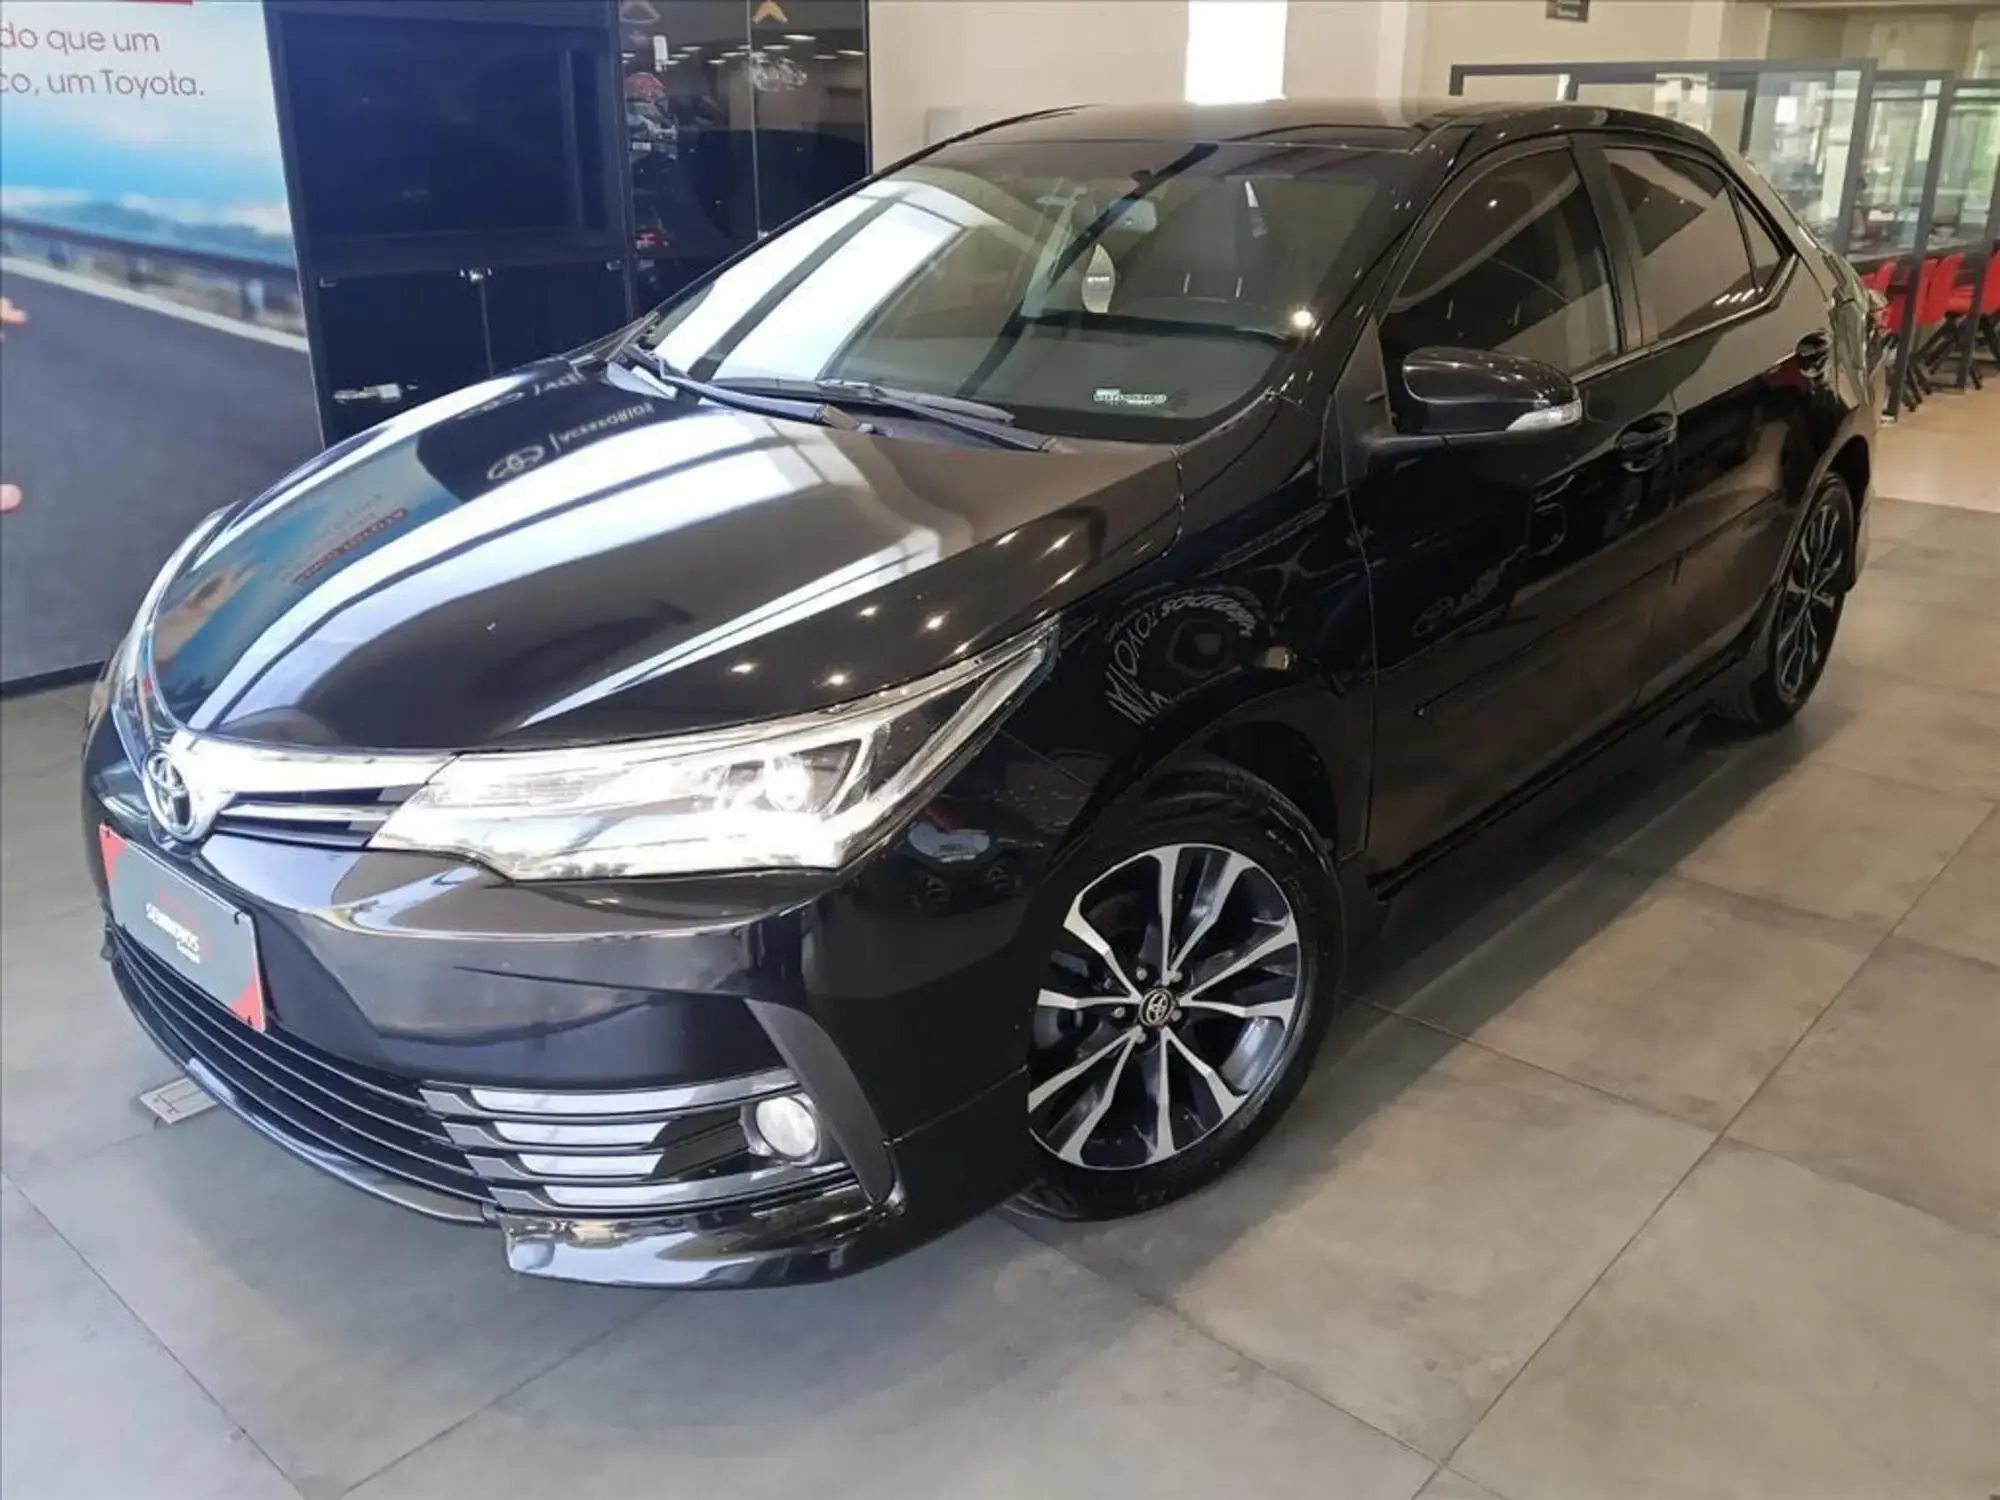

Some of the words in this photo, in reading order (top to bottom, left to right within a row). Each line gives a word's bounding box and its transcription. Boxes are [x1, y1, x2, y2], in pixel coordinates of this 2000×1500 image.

[46, 29, 106, 56] que
[113, 32, 160, 52] um
[46, 73, 95, 94] um
[99, 69, 205, 100] Toyota.
